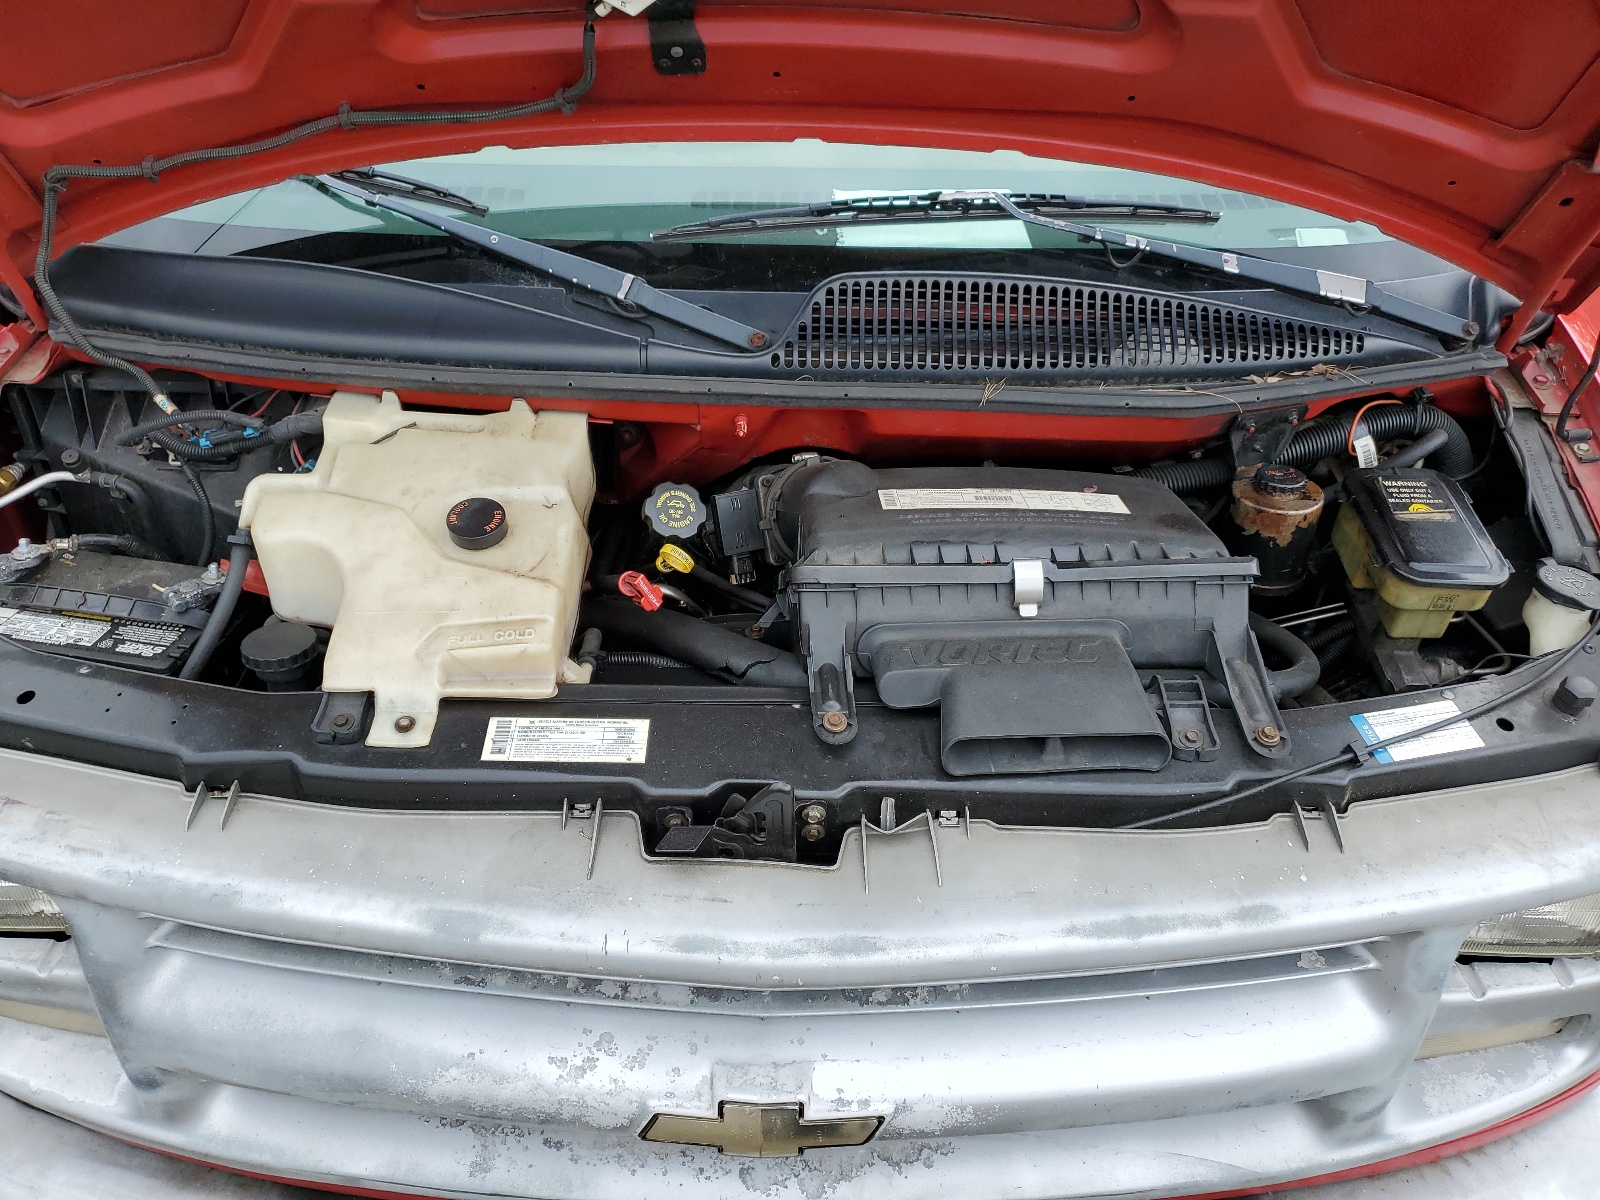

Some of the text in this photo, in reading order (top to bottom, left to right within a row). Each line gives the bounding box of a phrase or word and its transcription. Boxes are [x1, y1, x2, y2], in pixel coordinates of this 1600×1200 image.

[483, 510, 502, 532] ENGINE
[658, 512, 694, 529] ENGINE OIL
[447, 628, 537, 645] FULL COLD
[900, 639, 1102, 667] VORTEC
